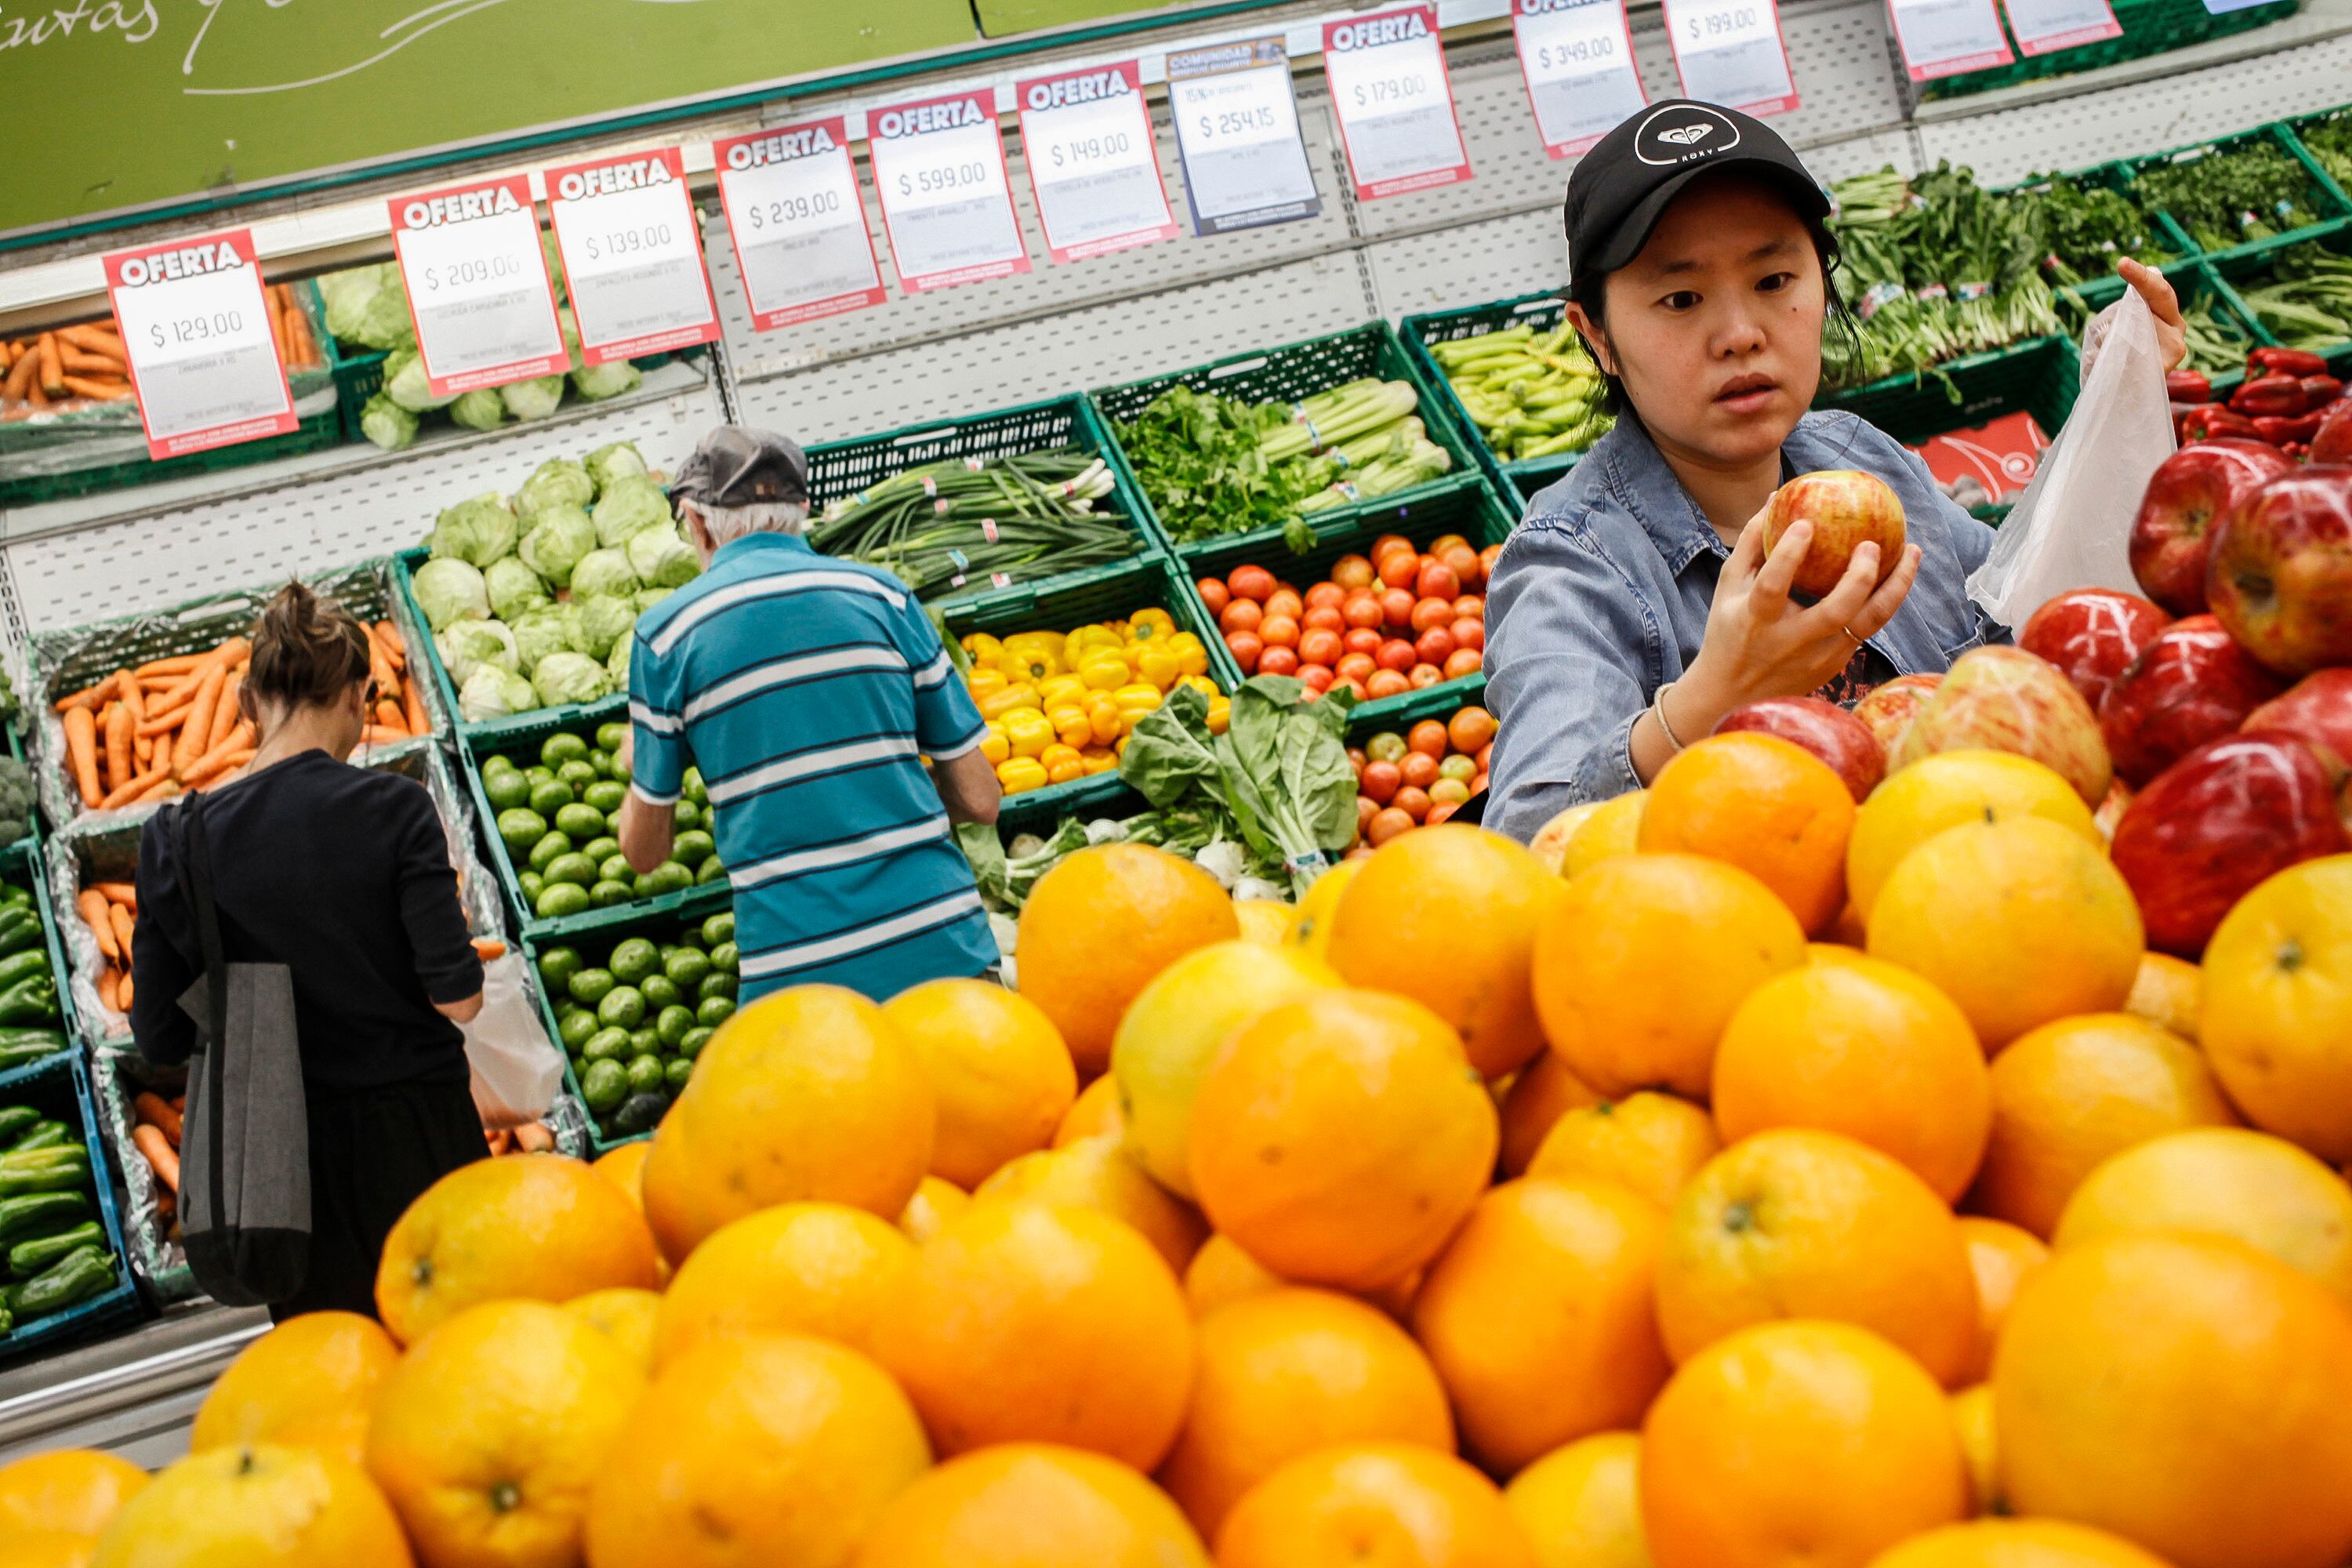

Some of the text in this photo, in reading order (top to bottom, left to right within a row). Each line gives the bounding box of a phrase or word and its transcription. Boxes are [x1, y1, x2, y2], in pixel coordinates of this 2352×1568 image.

[1332, 13, 1429, 53] OFERTA
[1689, 18, 1700, 38] $
[1539, 47, 1551, 68] $
[1026, 70, 1131, 111] OFERTA
[1355, 85, 1367, 106] $
[878, 97, 985, 139] OFERTA
[1200, 116, 1213, 137] $
[726, 125, 836, 170] OFERTA
[1051, 144, 1064, 166] $
[1682, 148, 1713, 162] ROXY
[558, 157, 671, 201] OFERTA
[899, 173, 912, 196] $
[403, 186, 520, 230] OFERTA
[750, 206, 764, 229] $
[586, 223, 672, 260] $ 139.00
[120, 240, 243, 288] OFERTA
[426, 268, 439, 290] $
[151, 310, 242, 348] $ 129.00
